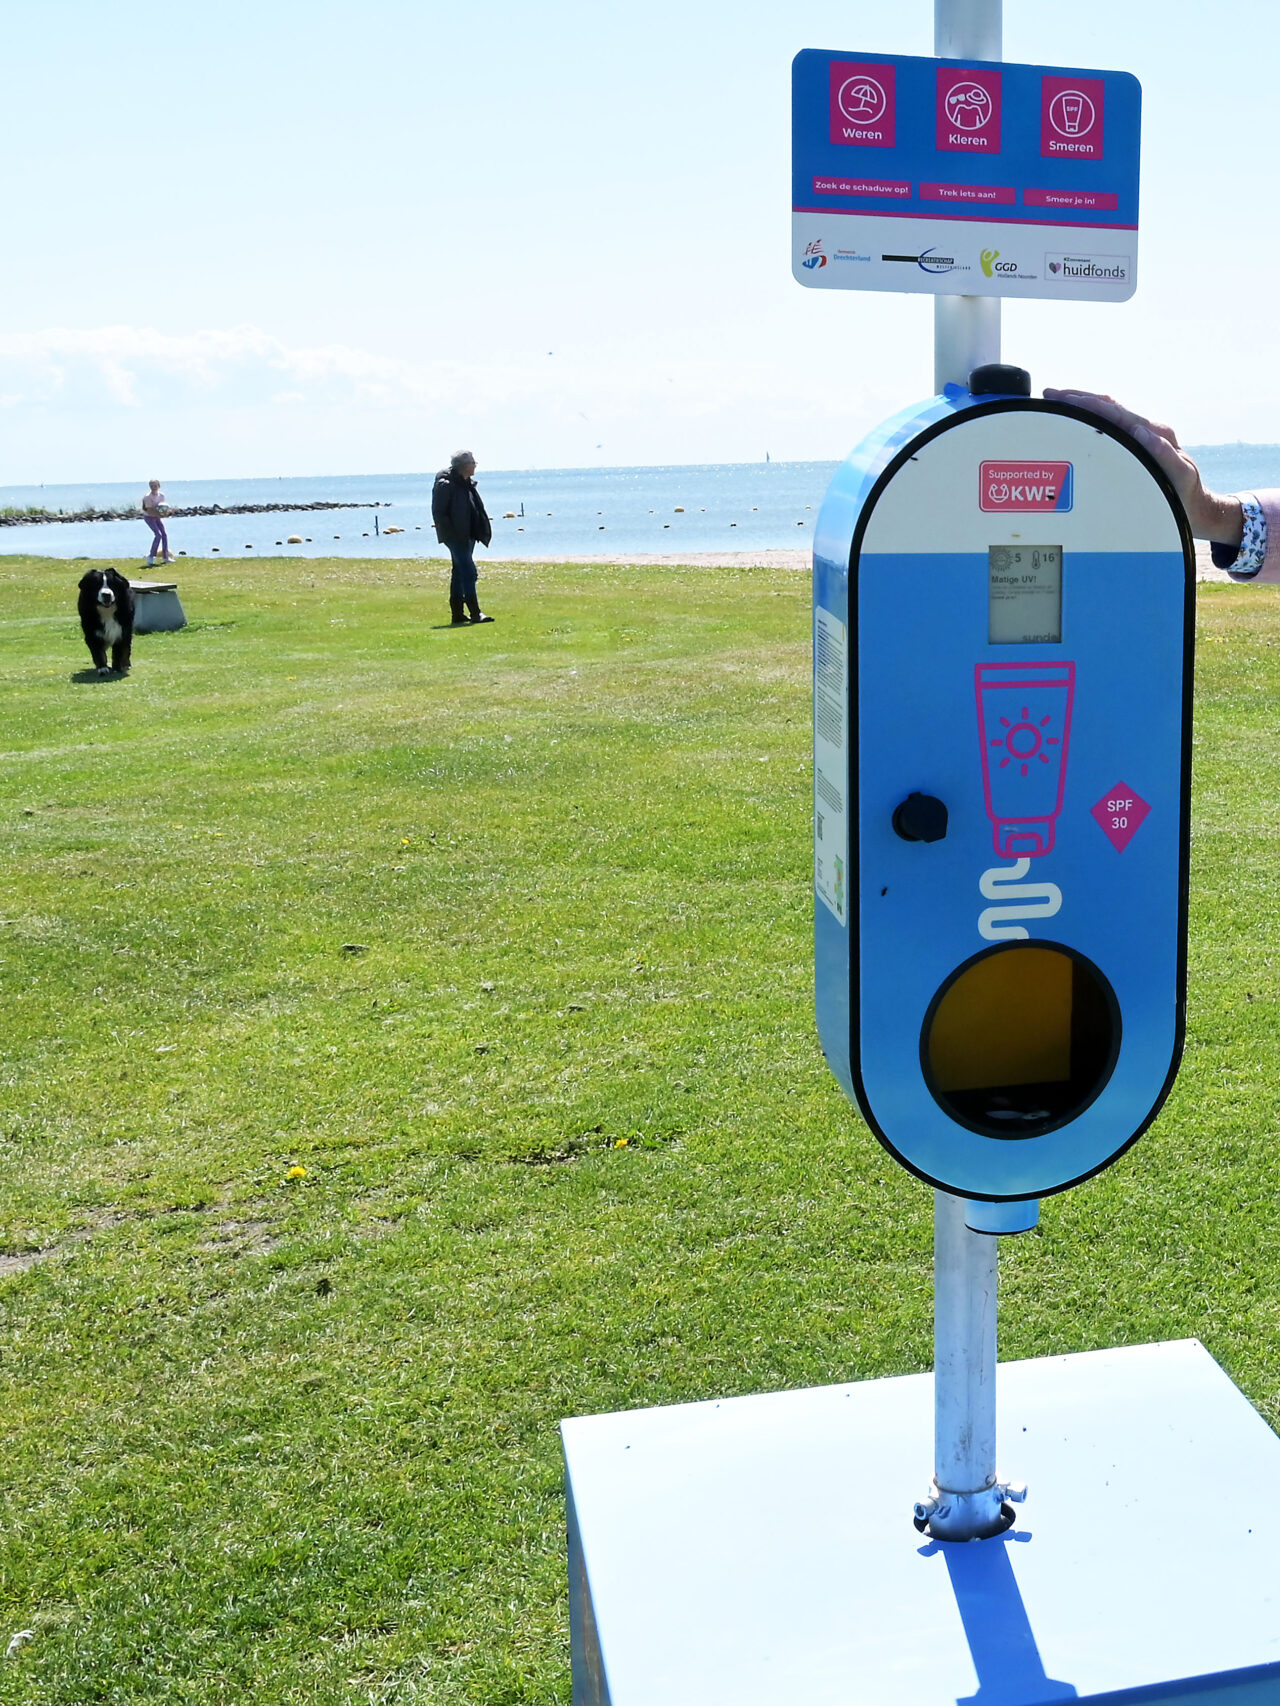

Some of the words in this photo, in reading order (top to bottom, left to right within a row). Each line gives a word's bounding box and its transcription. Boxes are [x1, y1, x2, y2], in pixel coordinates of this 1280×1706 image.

[842, 128, 882, 140] Weren
[949, 134, 987, 146] Kleren
[1049, 141, 1094, 152] Smeren
[815, 181, 837, 190] Zoek
[852, 185, 892, 193] schaduw
[894, 187, 909, 195] op!
[939, 189, 958, 197] Trek
[960, 190, 976, 198] iets
[1046, 196, 1073, 204] Smeer
[1074, 198, 1083, 206] je
[995, 262, 1017, 272] GGD
[1063, 263, 1126, 278] huidfonds
[988, 469, 1040, 480] Supported
[1042, 470, 1054, 480] by
[1011, 486, 1056, 501] KWF
[1014, 553, 1021, 562] 5
[991, 576, 1018, 584] Matige
[1107, 799, 1133, 812] SPF
[1111, 816, 1128, 829] 30
